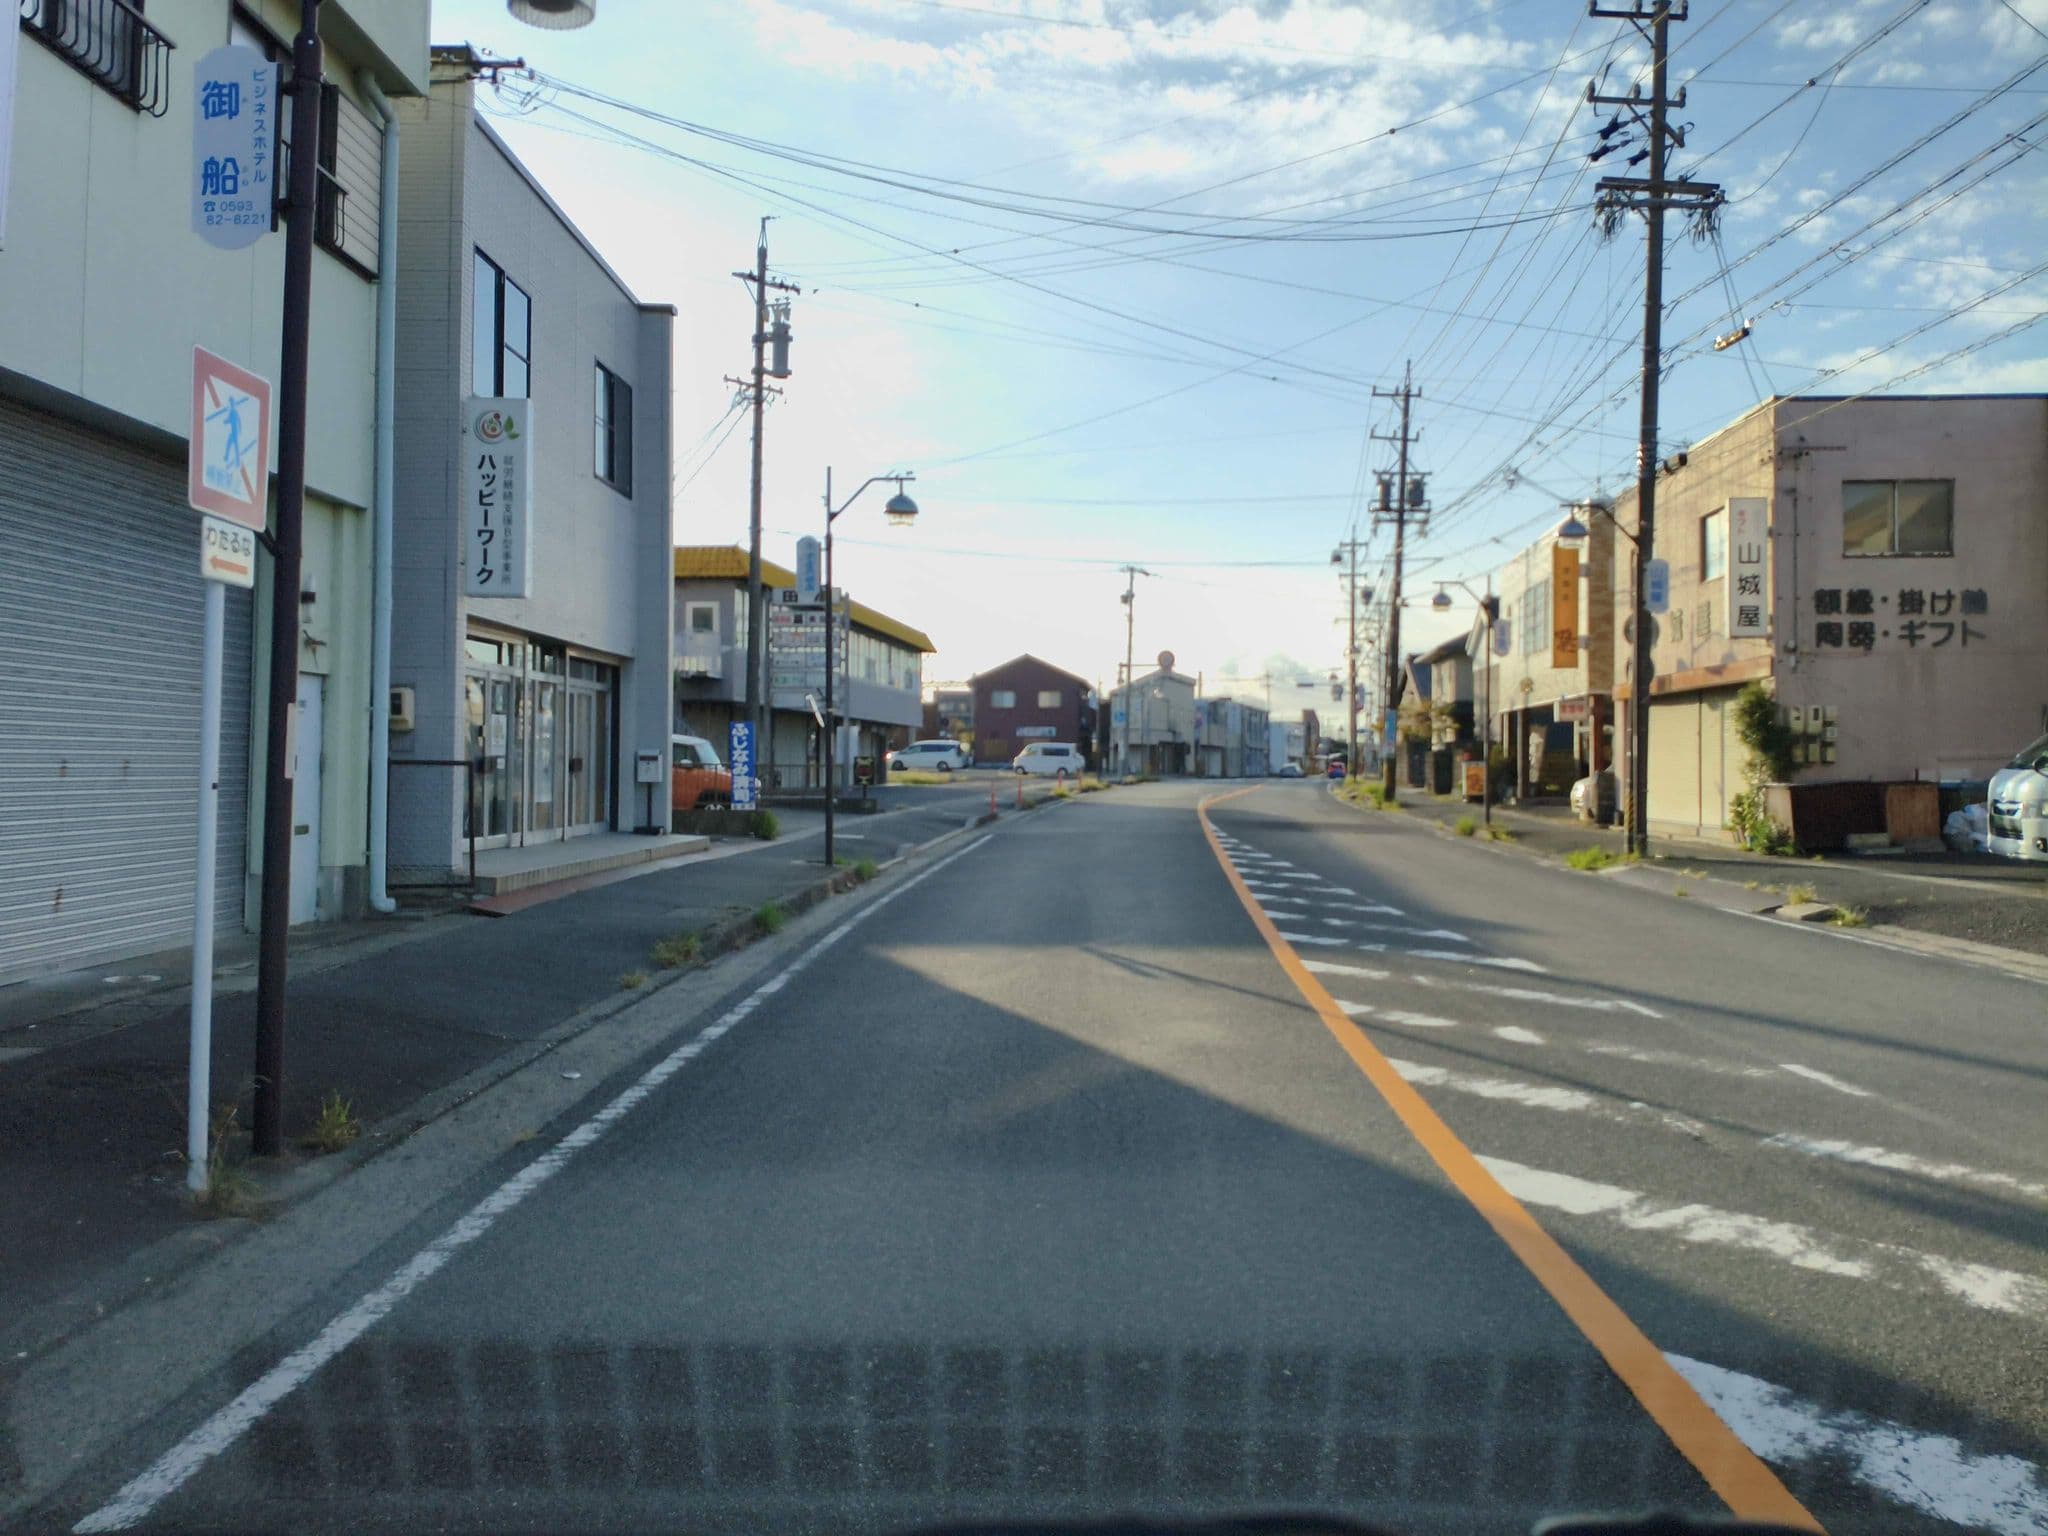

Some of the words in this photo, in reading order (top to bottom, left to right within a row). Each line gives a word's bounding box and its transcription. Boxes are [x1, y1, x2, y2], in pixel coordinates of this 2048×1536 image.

[201, 80, 240, 195] 御船
[253, 69, 267, 183] ビジネスホテル
[220, 200, 253, 211] 0593
[205, 526, 252, 557] わたるな
[477, 454, 496, 585] ハッピーワーク
[1737, 542, 1761, 628] 山城屋
